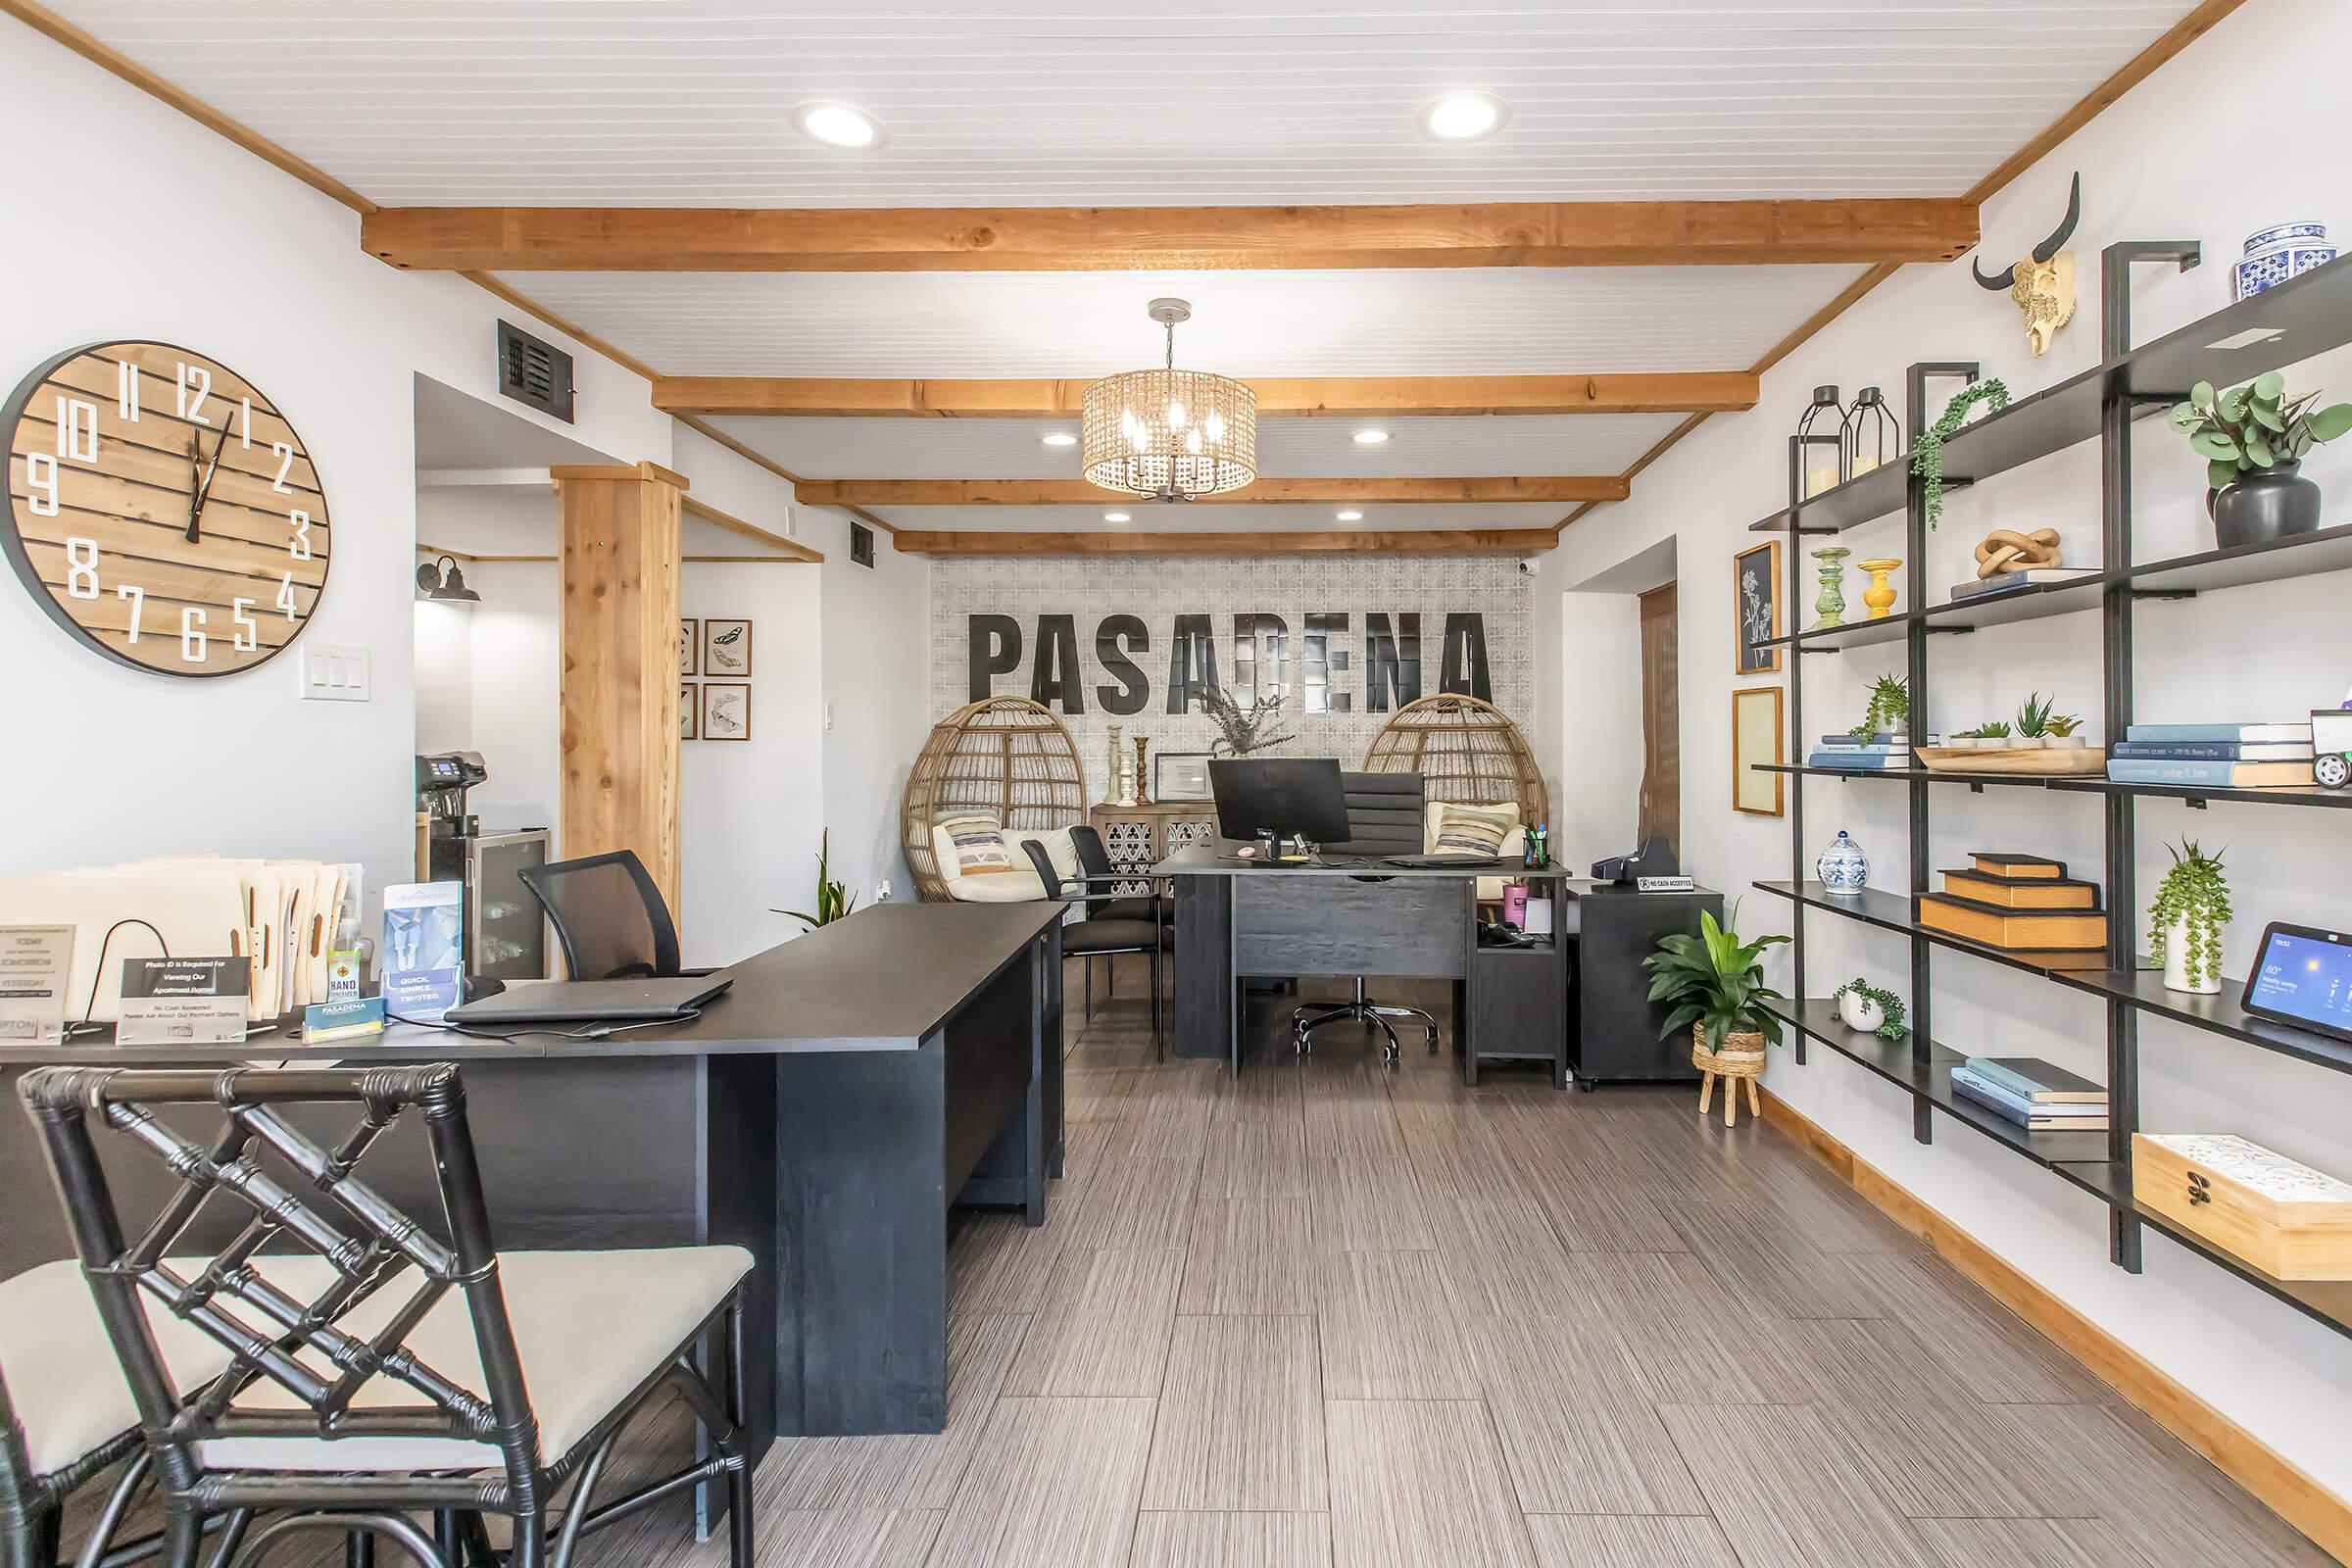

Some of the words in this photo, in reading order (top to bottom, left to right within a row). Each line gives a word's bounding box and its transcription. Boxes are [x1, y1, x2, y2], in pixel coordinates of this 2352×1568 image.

[120, 361, 139, 422] 11
[176, 362, 211, 424] 12
[57, 396, 98, 464] 10
[242, 397, 251, 450] 1
[27, 452, 59, 516] 9
[273, 442, 293, 494] 2
[290, 509, 311, 562] 3
[67, 537, 99, 600] 8
[276, 571, 297, 622] 4
[118, 585, 144, 643] 7
[182, 607, 207, 662] 6
[234, 598, 257, 652] 5
[968, 612, 1492, 715] PASADENA
[330, 980, 356, 990] HAND
